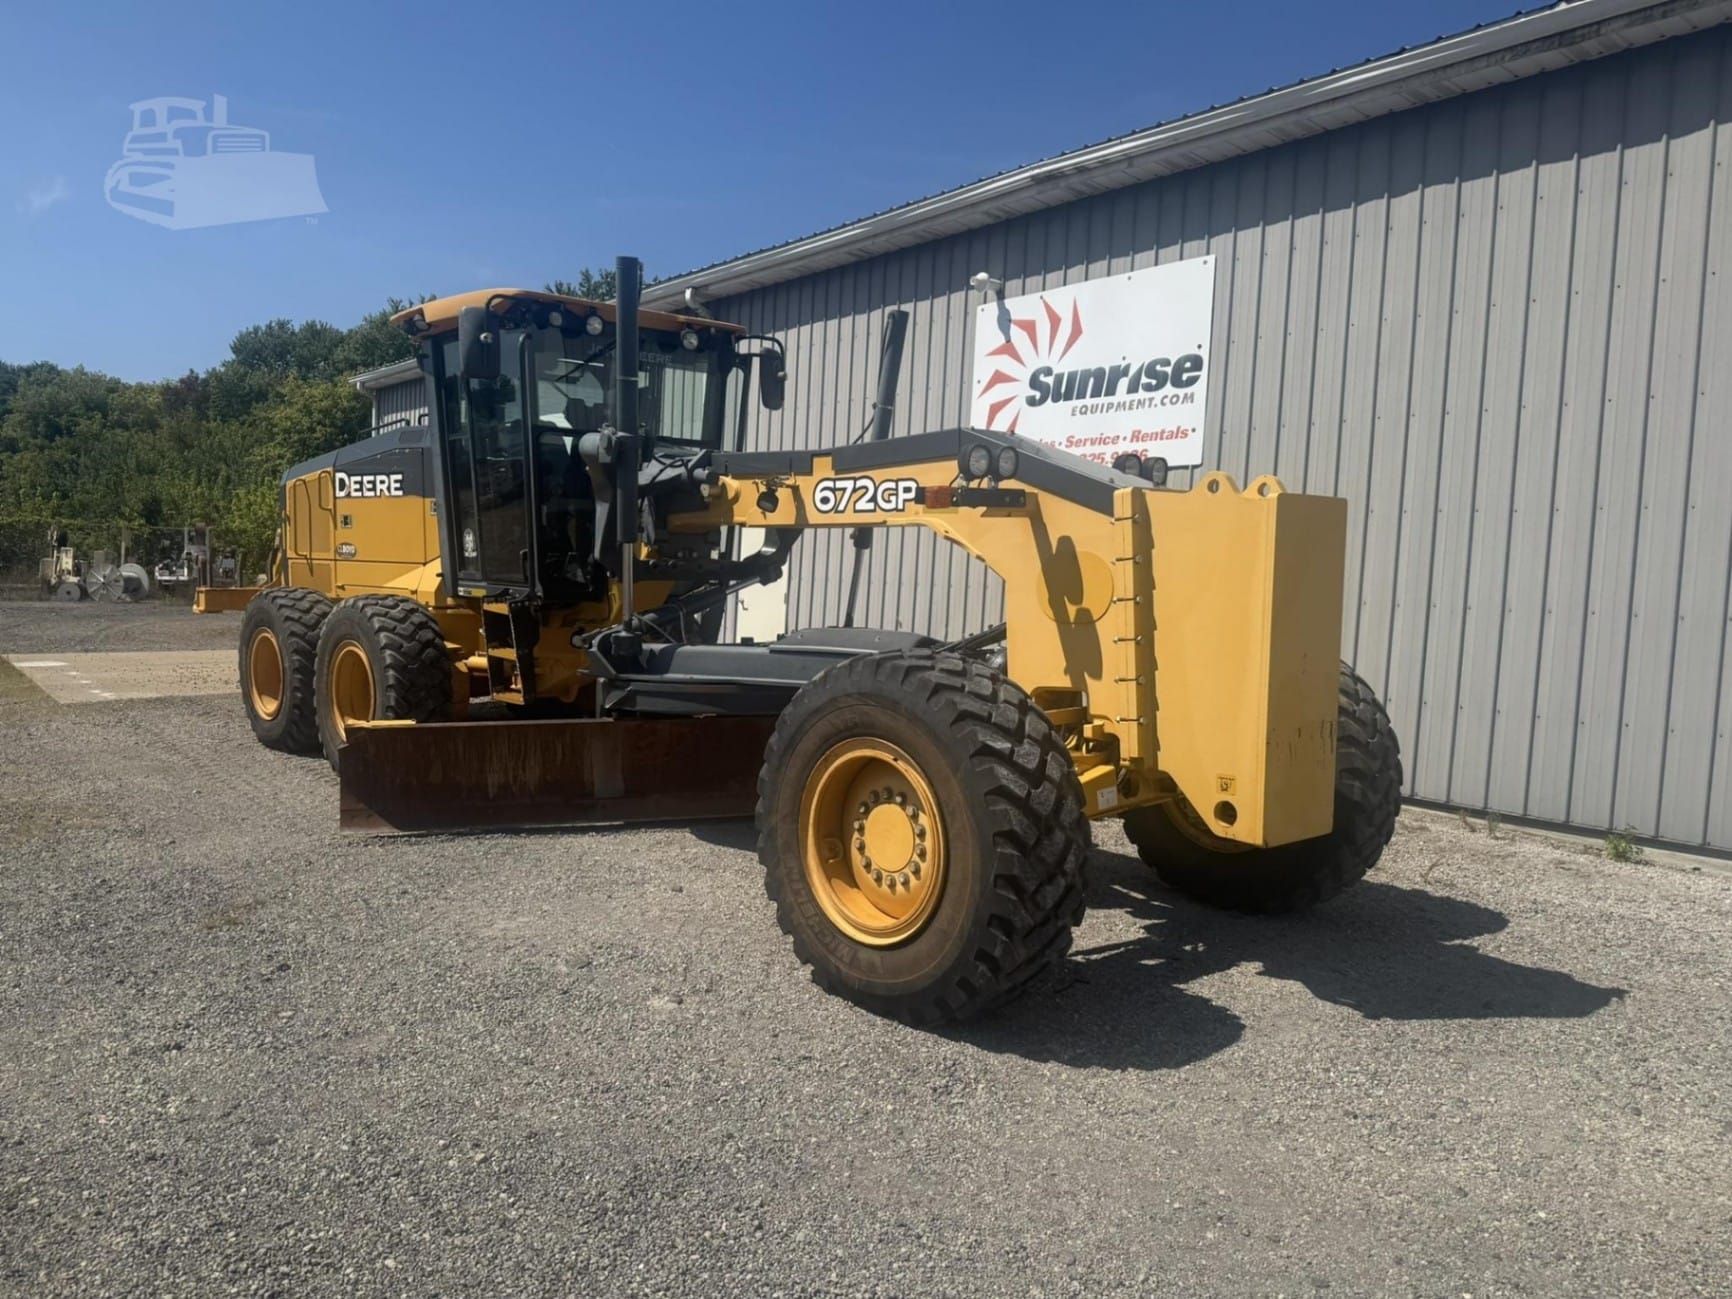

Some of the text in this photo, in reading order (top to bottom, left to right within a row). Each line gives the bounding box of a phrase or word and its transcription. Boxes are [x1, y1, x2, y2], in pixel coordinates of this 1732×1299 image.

[1025, 353, 1204, 408] Sunrise
[1070, 392, 1195, 417] EQUIPMENT.COM
[1064, 433, 1121, 449] Service
[1129, 425, 1190, 443] Rentals
[334, 471, 404, 498] DEERE
[813, 476, 919, 513] 672GP
